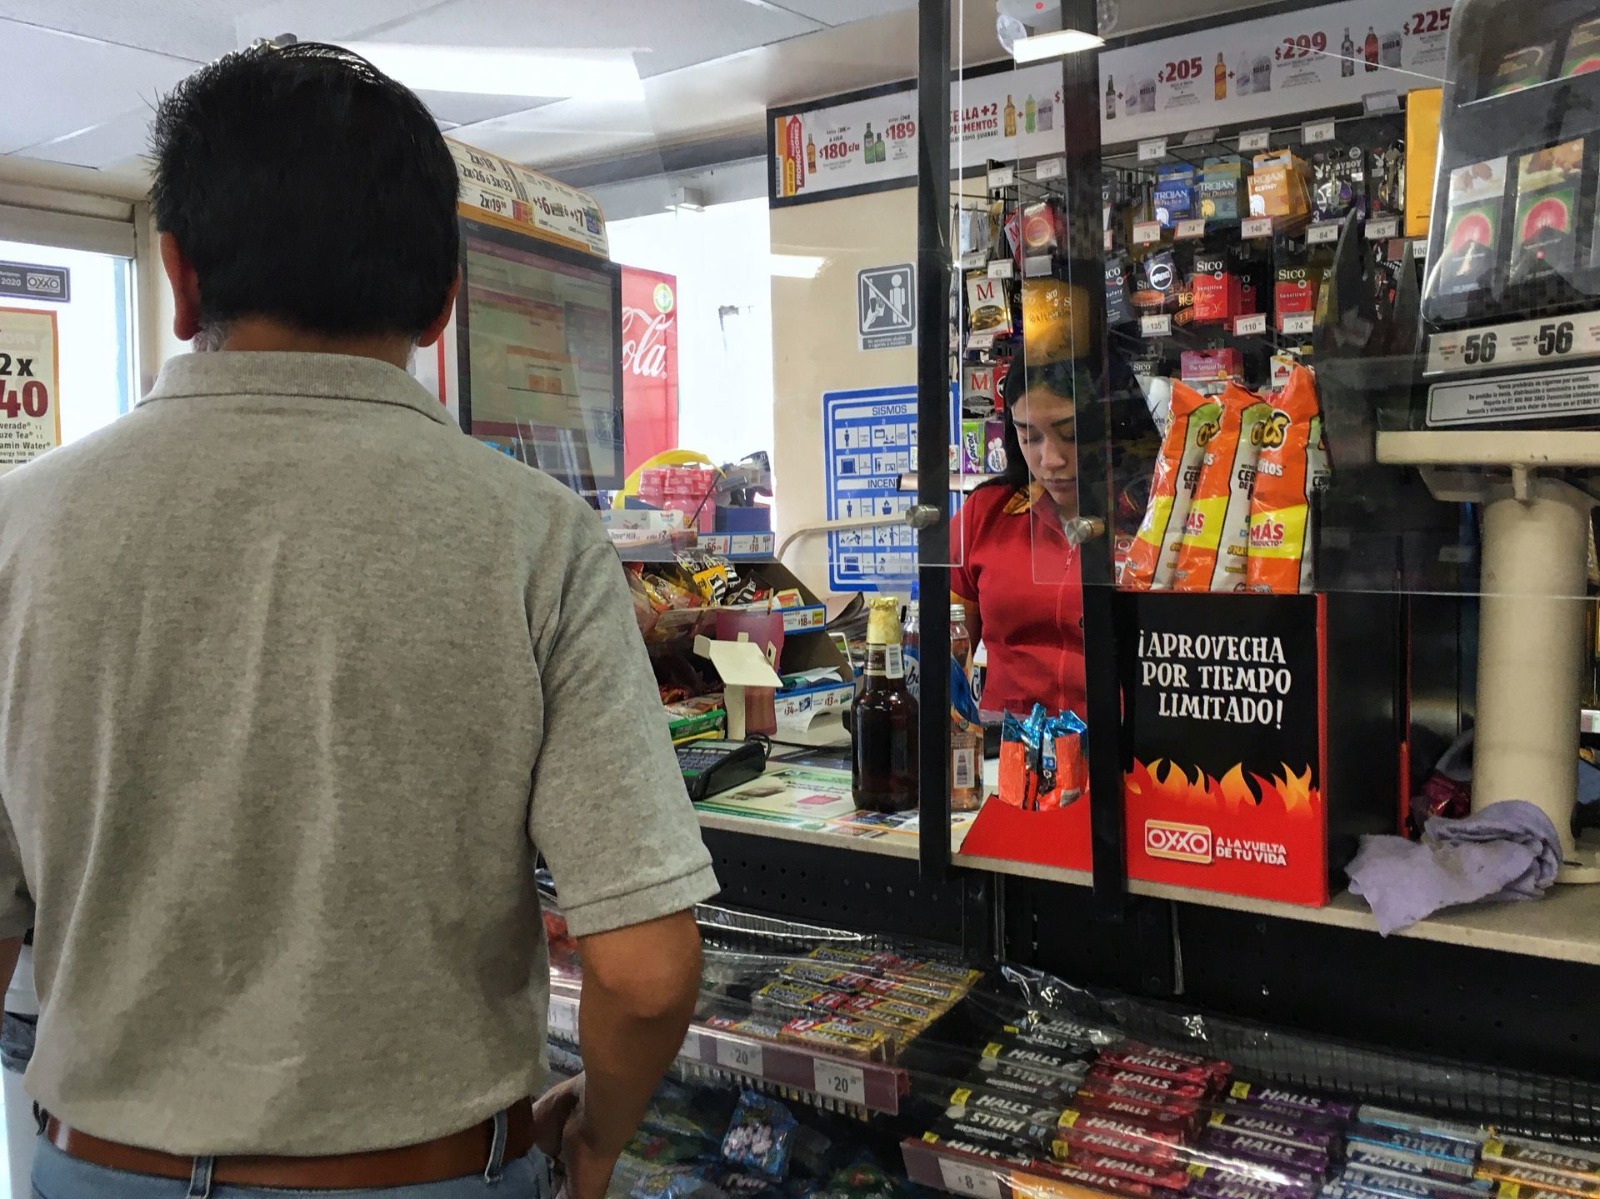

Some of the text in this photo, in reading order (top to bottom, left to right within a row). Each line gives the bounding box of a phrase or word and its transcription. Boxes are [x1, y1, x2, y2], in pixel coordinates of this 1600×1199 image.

[1275, 31, 1327, 61] $299
[1158, 57, 1203, 83] $205
[885, 121, 916, 141] $189
[795, 121, 803, 186] PROMOCIONES
[819, 141, 848, 160] $180
[1155, 190, 1188, 200] TROJAN
[1200, 181, 1234, 193] TROJAN
[1197, 260, 1224, 272] SICO
[1278, 268, 1306, 280] SICO
[1, 276, 59, 289] 2020 OXXO
[976, 281, 995, 301] M
[1460, 332, 1498, 366] $56
[1533, 320, 1575, 358] $56
[970, 373, 990, 391] M
[871, 404, 908, 417] SISMOS
[1138, 629, 1287, 665] ¡APROVECHA
[1141, 661, 1292, 695] POR TIEMPO
[1158, 692, 1284, 730] LIMITADO!
[1148, 829, 1209, 854] OXXO
[1216, 836, 1287, 855] A LA VUELTA
[1216, 846, 1287, 866] DE TU VIDA
[1008, 1048, 1061, 1066] HALLS
[1122, 1055, 1180, 1072] HALLS
[1113, 1071, 1172, 1090] HALLS
[975, 1094, 1032, 1115] HALLS
[1258, 1088, 1321, 1108] HALLS
[1108, 1101, 1151, 1116] HALLS
[1086, 1117, 1147, 1136] HALLS
[1235, 1116, 1297, 1137] HALLS
[1082, 1133, 1143, 1153] HALLS
[1231, 1136, 1297, 1157] HALLS
[1095, 1157, 1156, 1178] HALLS
